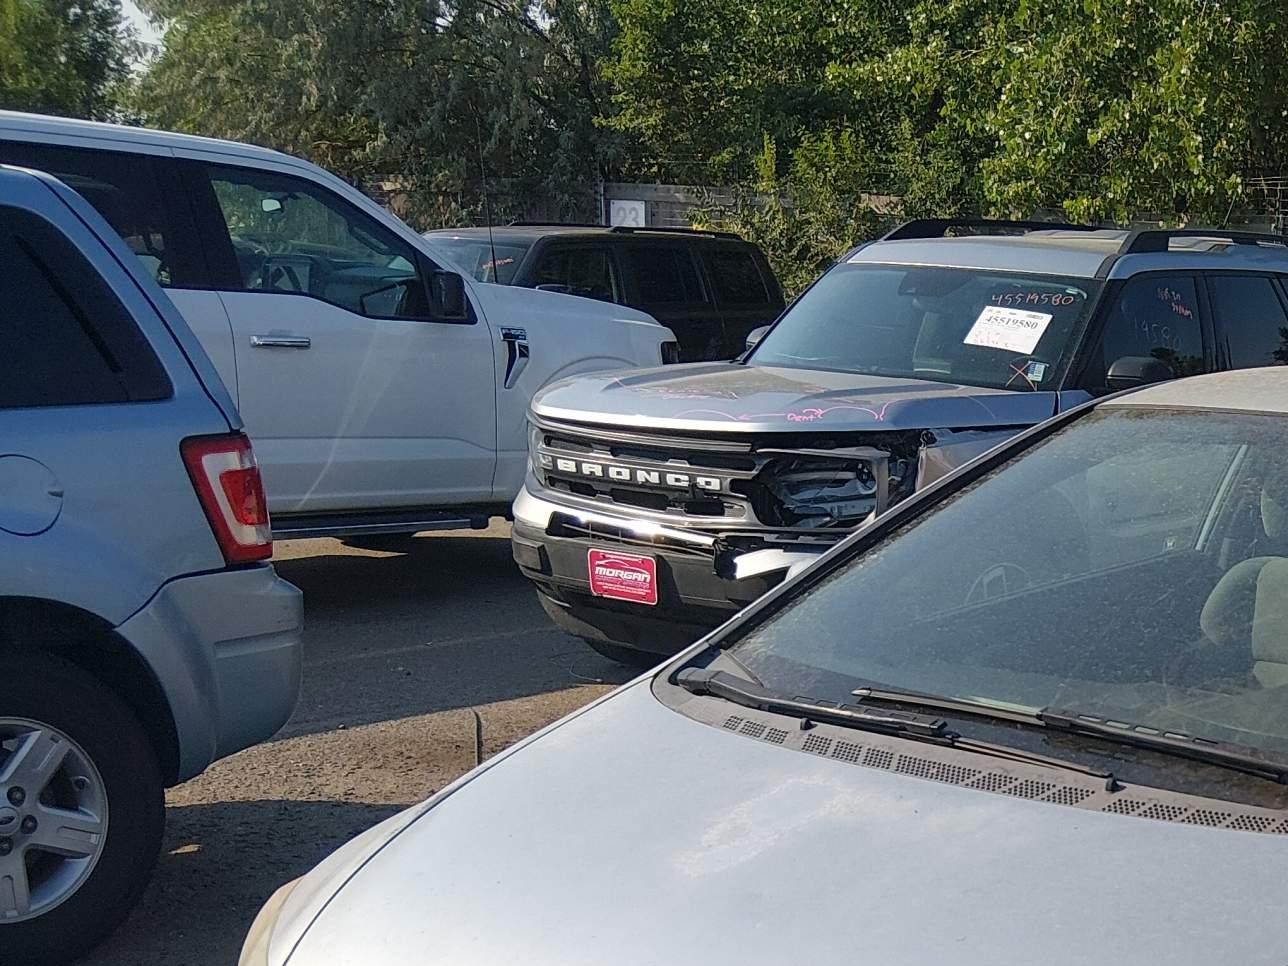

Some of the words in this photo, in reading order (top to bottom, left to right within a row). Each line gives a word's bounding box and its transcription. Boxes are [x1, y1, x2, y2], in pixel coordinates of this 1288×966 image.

[991, 292, 1075, 306] 45519580
[985, 315, 1039, 331] 45519580
[557, 458, 722, 491] BRONCO
[594, 566, 651, 584] MORGAN
